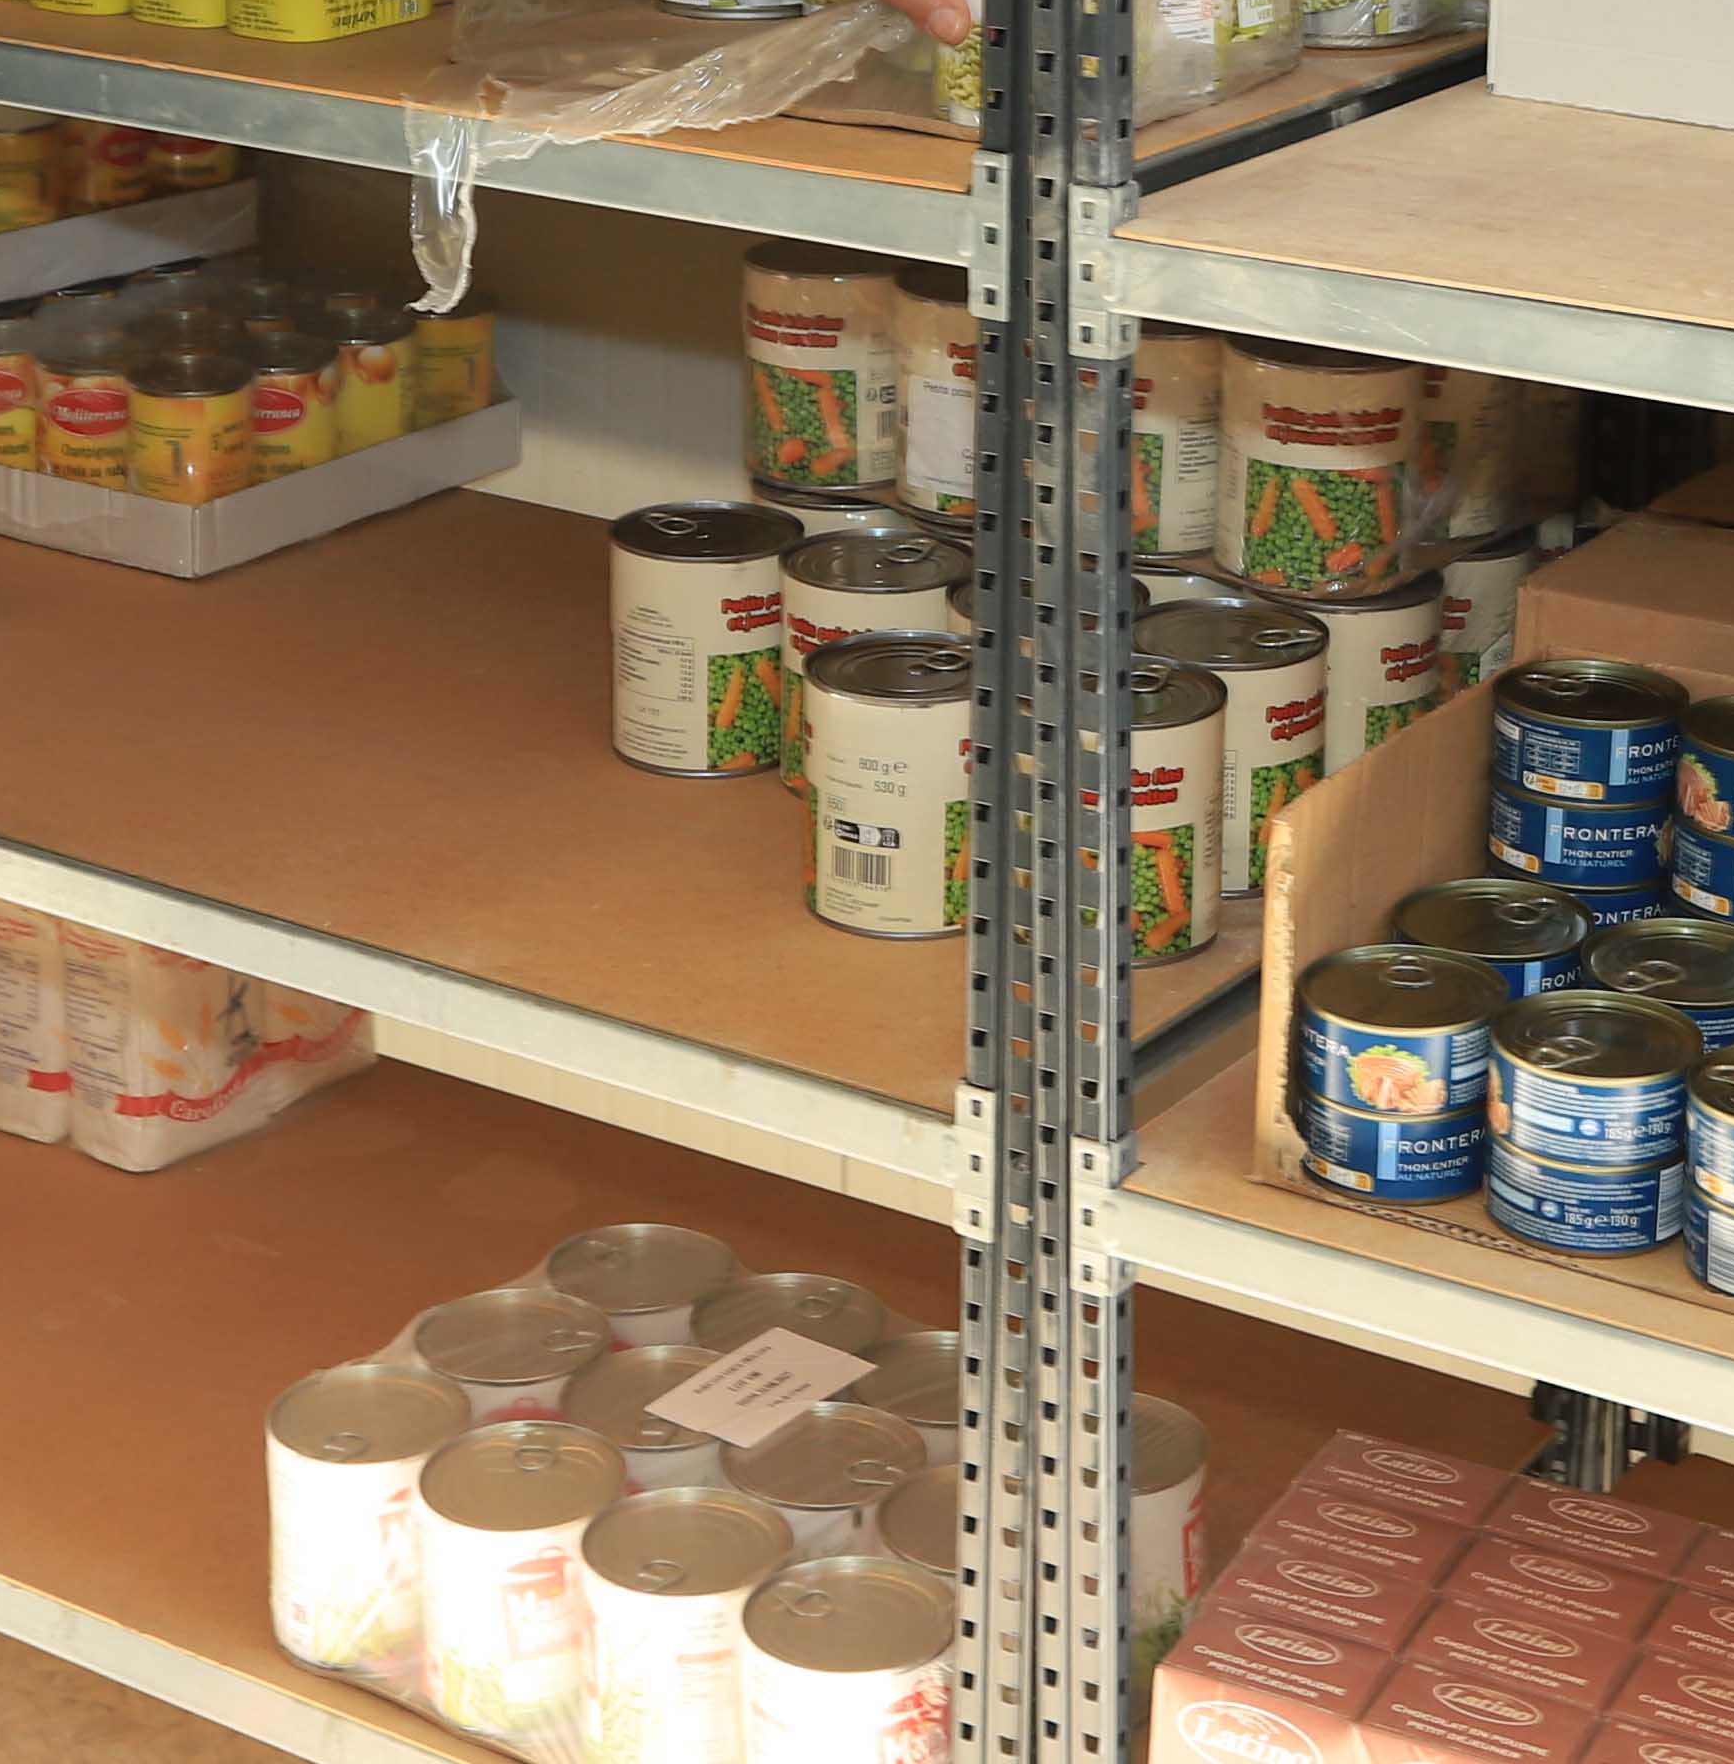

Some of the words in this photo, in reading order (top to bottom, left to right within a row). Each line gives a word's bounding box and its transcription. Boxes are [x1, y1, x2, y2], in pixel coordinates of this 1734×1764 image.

[721, 595, 765, 614] Petits
[1266, 700, 1305, 723] Petits
[1616, 735, 1679, 758] FRONTE
[874, 780, 894, 794] 530
[1550, 824, 1657, 841] FRONTERA
[1563, 849, 1592, 859] THON
[1595, 849, 1633, 858] ENTIER
[1581, 859, 1626, 867] NATUREL
[1593, 903, 1662, 925] ONTERA
[1397, 1163, 1426, 1172] THON
[1429, 1156, 1468, 1171] ENTIER
[1417, 1169, 1461, 1180] NATUREL
[1564, 1212, 1582, 1225] 185
[1371, 1453, 1451, 1481] Latino
[1325, 1507, 1408, 1534] Latino
[1560, 1502, 1642, 1531] Latino
[1286, 1564, 1371, 1594] Latino
[1519, 1558, 1602, 1588] Latino
